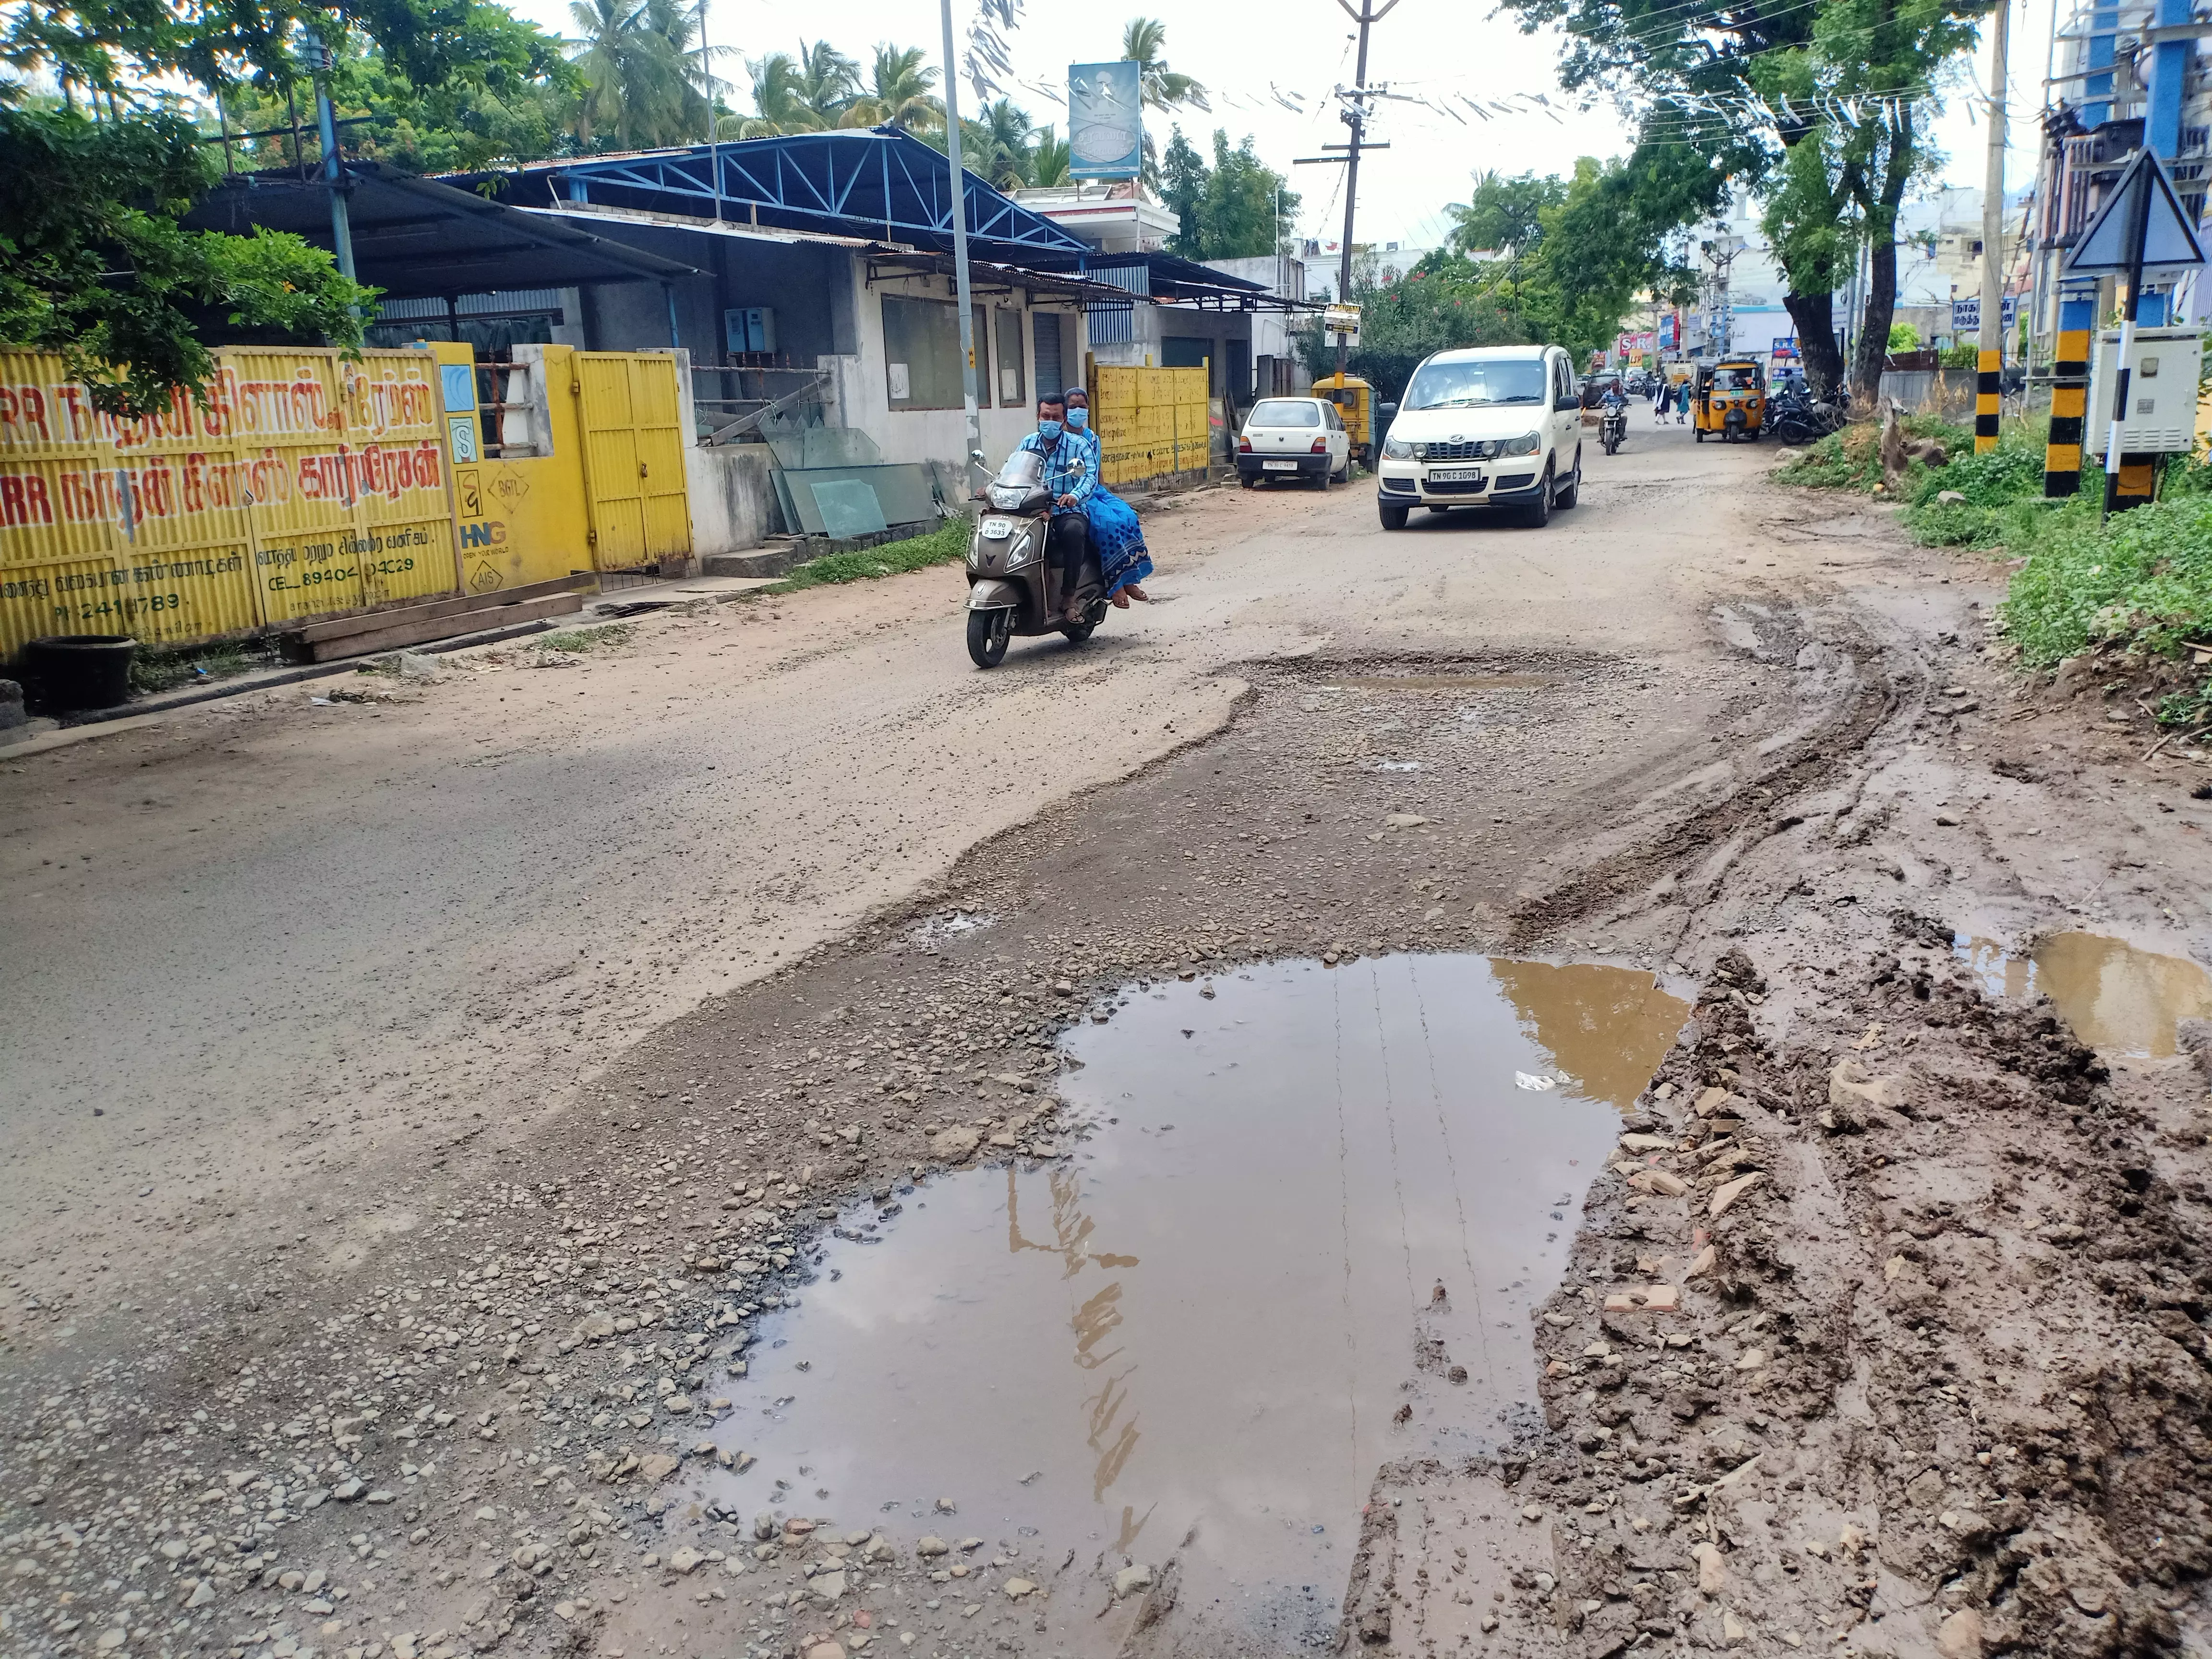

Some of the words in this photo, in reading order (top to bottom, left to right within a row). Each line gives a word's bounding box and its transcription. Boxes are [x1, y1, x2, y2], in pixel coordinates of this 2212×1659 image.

[0, 476, 53, 527] RR
[459, 521, 506, 549] HNG
[491, 546, 509, 555] WORLD
[479, 571, 493, 586] AIS
